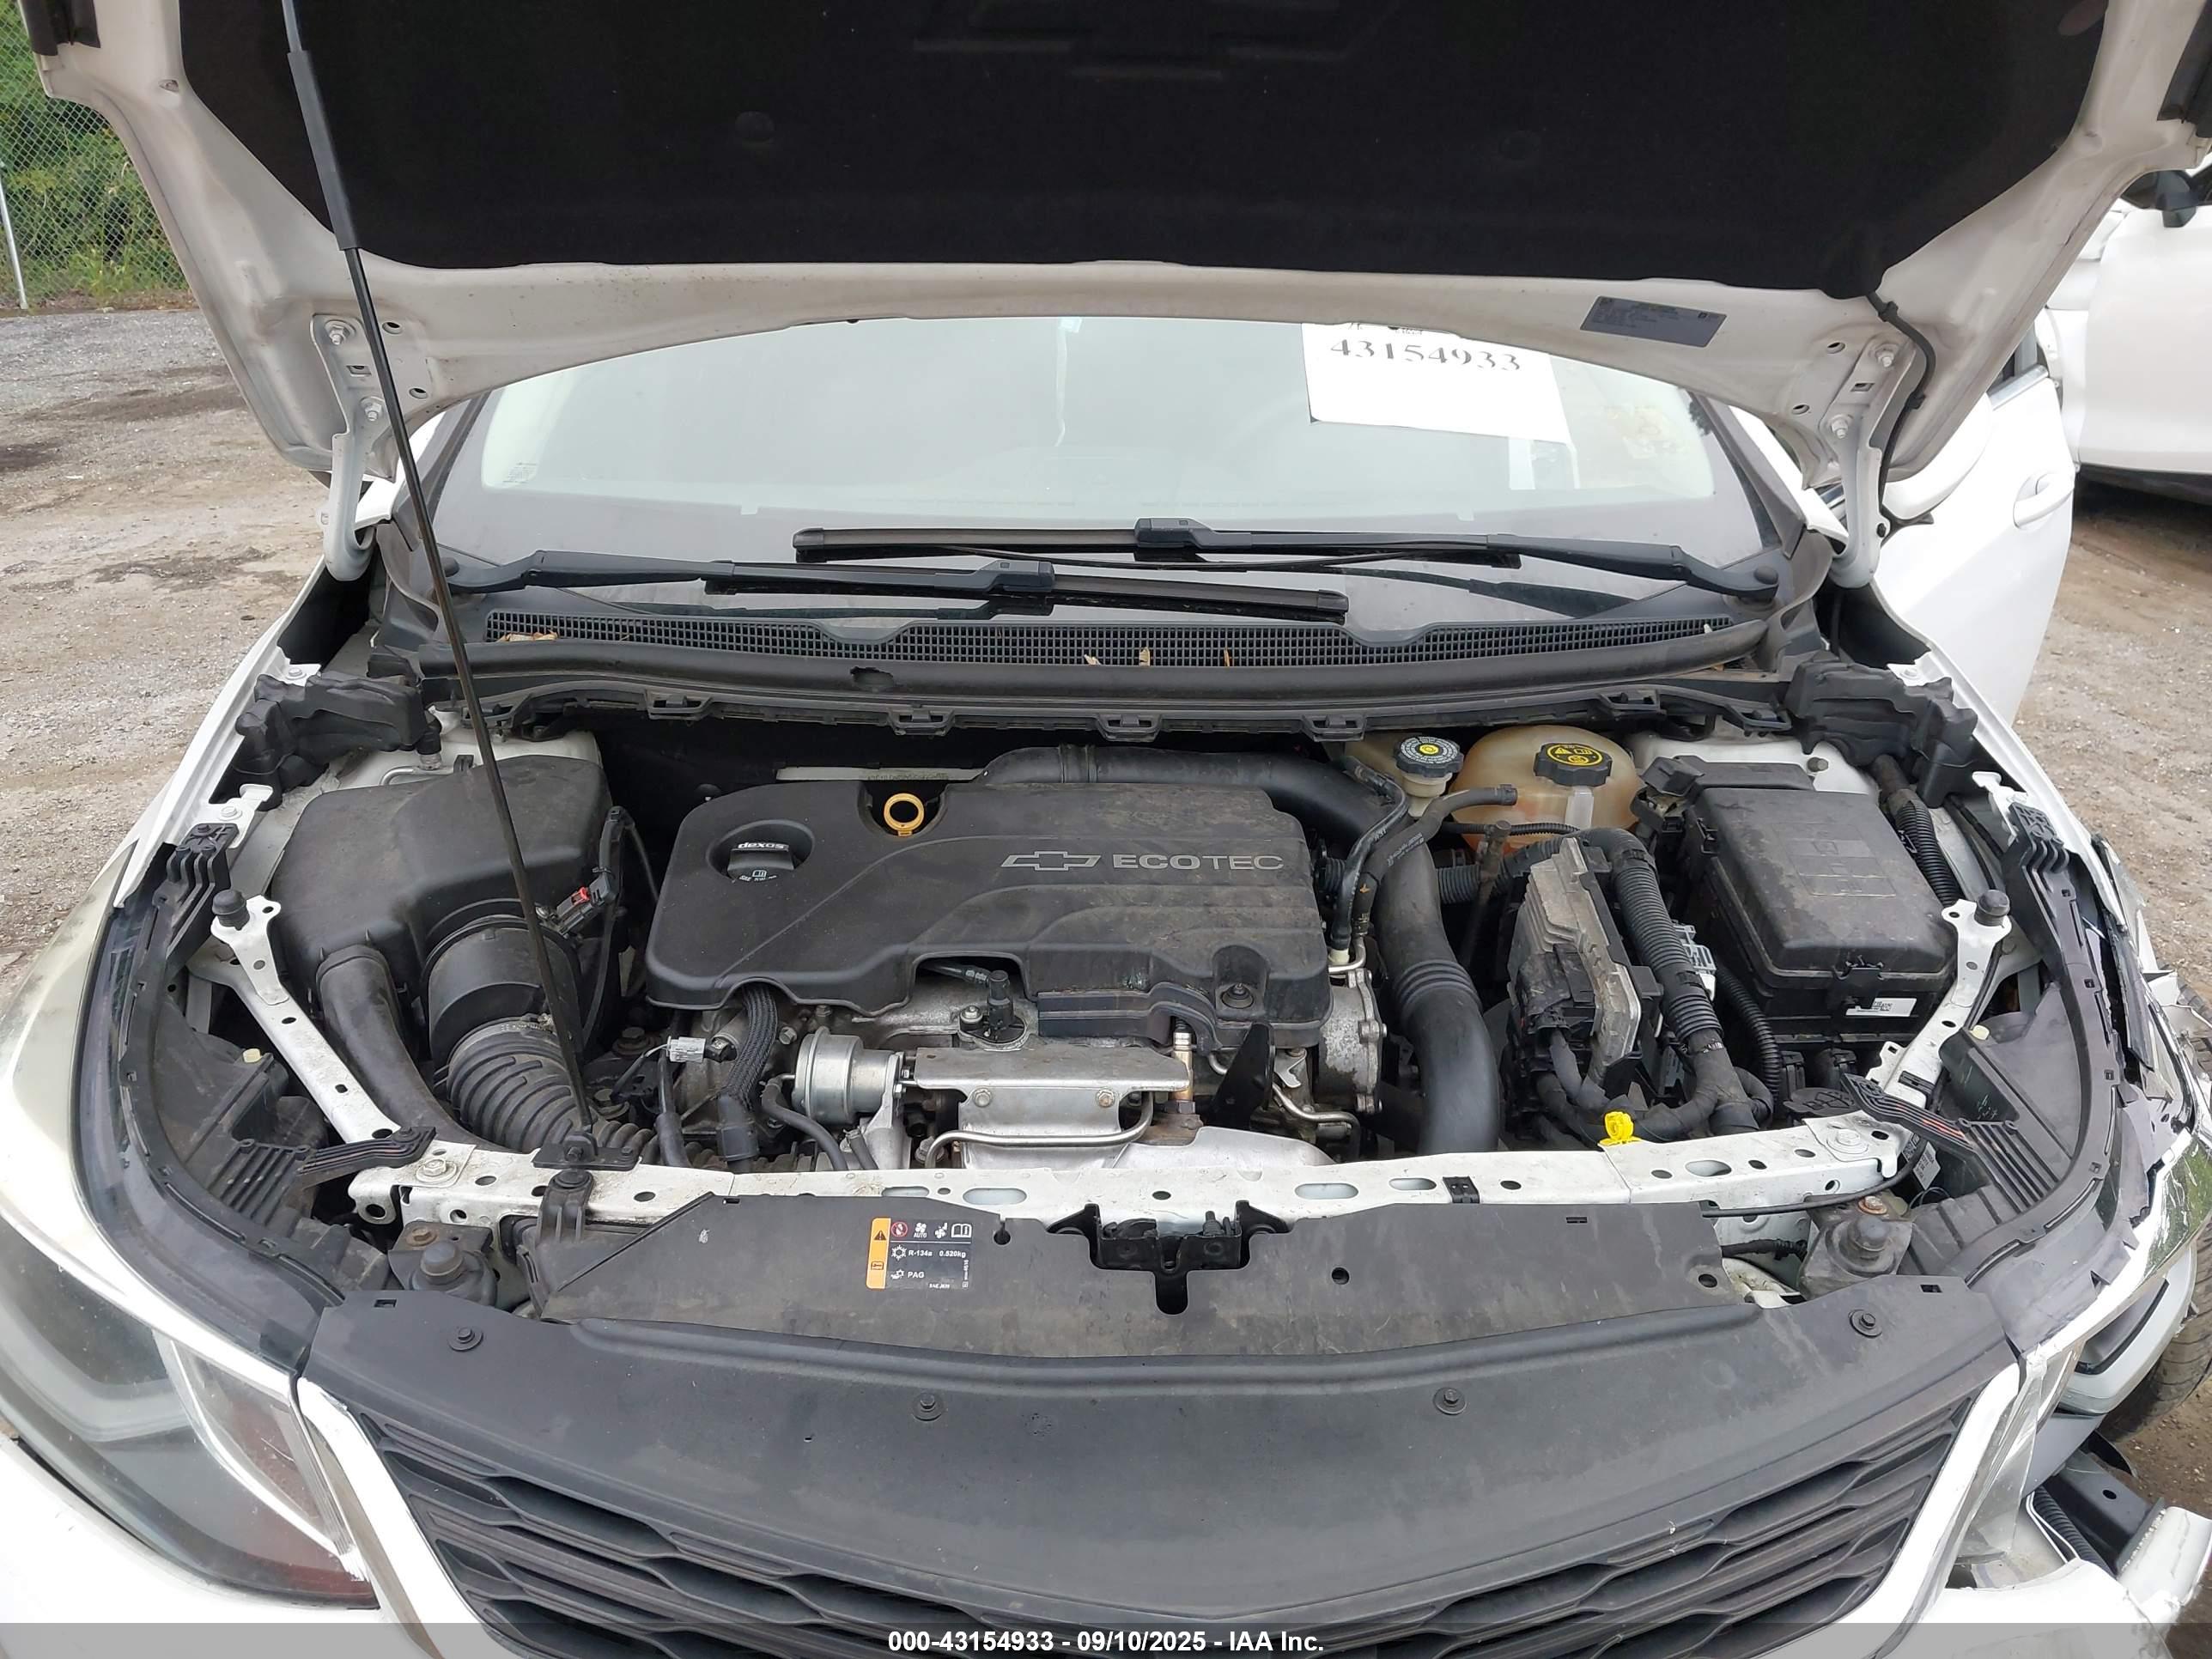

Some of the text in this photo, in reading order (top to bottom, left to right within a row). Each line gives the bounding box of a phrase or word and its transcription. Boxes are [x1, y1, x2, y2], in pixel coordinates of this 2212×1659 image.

[1330, 338, 1522, 371] 43154933
[1112, 854, 1285, 871] ECOTEC
[939, 1250, 967, 1259] 0.520kg
